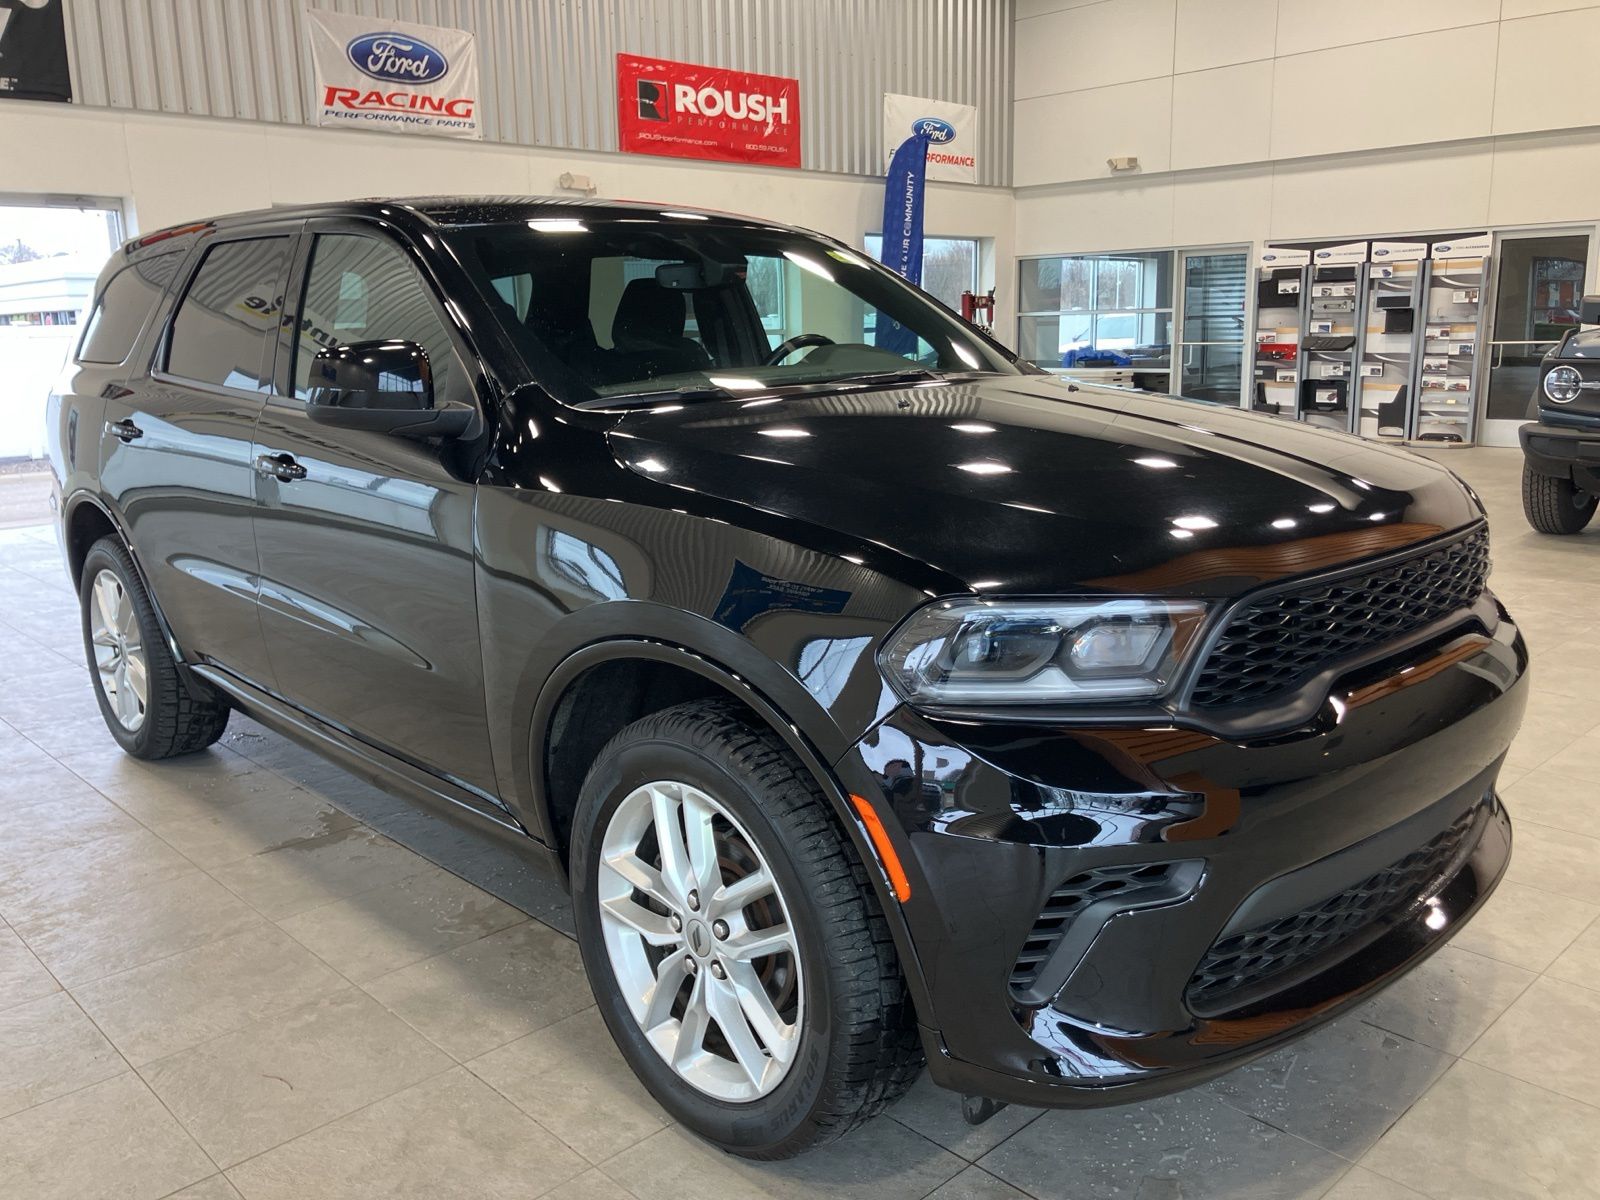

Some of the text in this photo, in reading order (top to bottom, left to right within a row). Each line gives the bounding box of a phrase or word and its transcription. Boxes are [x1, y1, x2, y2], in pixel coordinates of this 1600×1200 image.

[367, 39, 429, 78] Ford
[323, 85, 475, 119] RACING
[324, 109, 476, 129] PERFORMANCE PARTS
[674, 83, 788, 125] ROUSH
[925, 152, 975, 168] RFORMANCE
[903, 171, 915, 235] COMMUNITY
